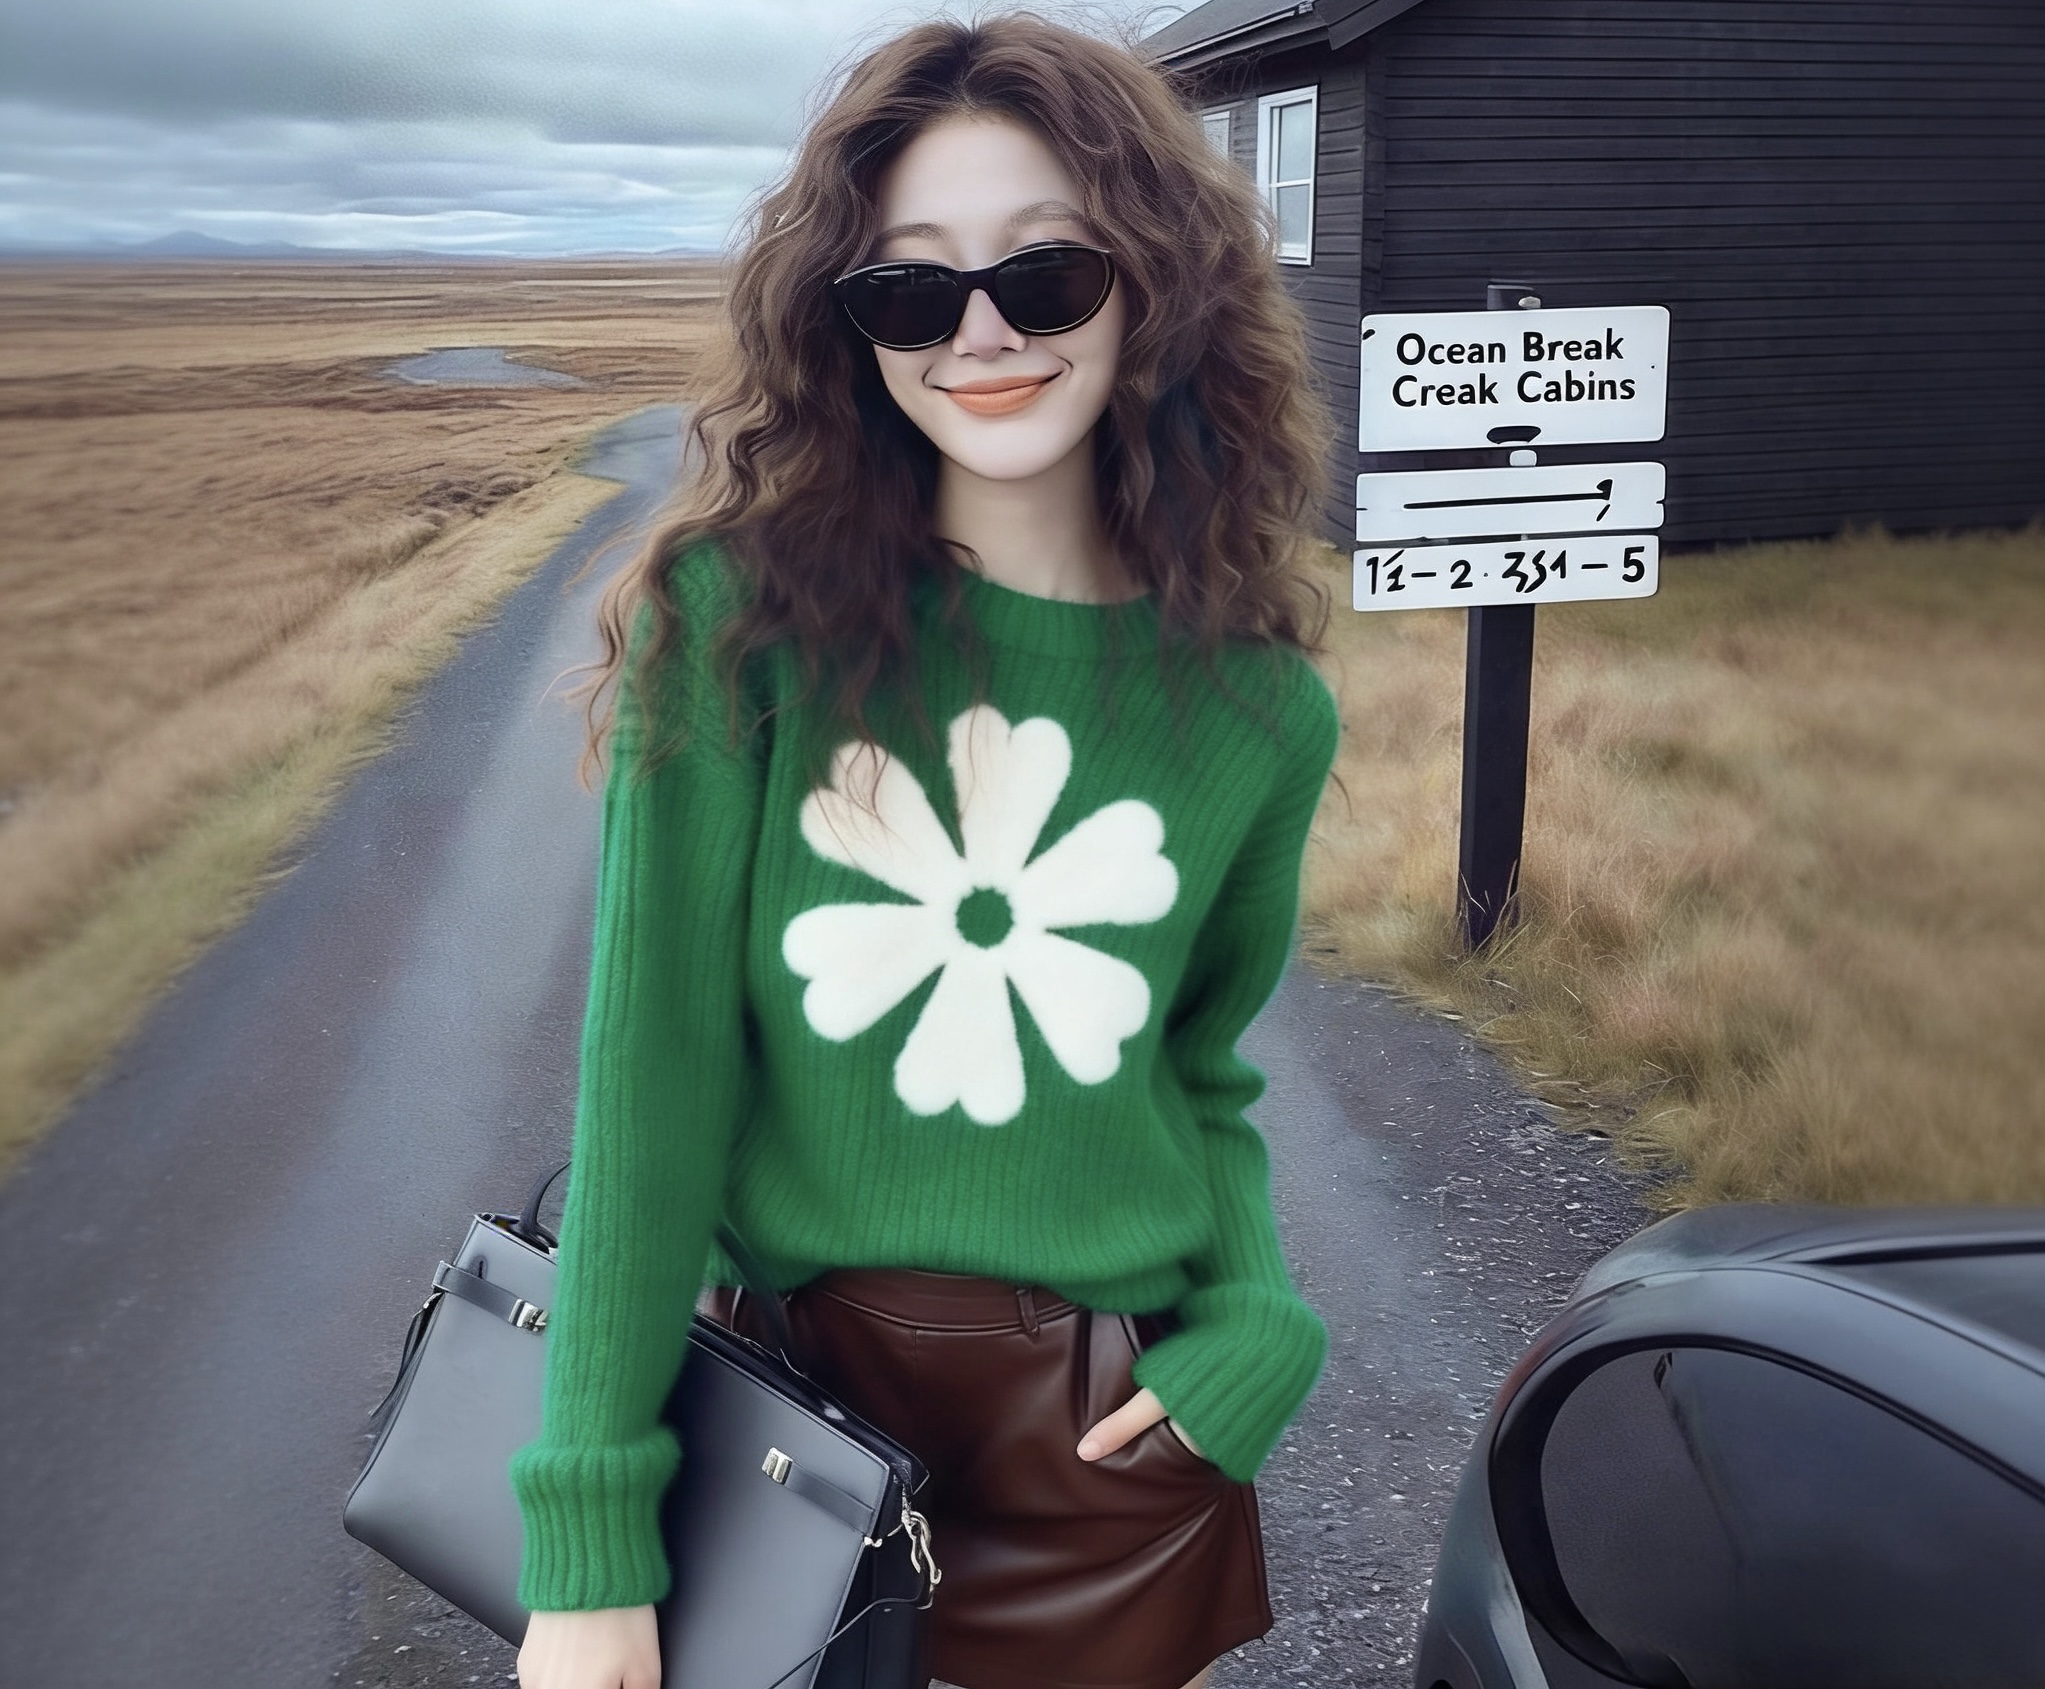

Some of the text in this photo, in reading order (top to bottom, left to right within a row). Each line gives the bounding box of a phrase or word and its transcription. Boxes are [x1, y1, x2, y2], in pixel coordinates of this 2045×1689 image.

[1396, 327, 1625, 366] Ocean Break
[1392, 370, 1636, 407] Creak Cabins
